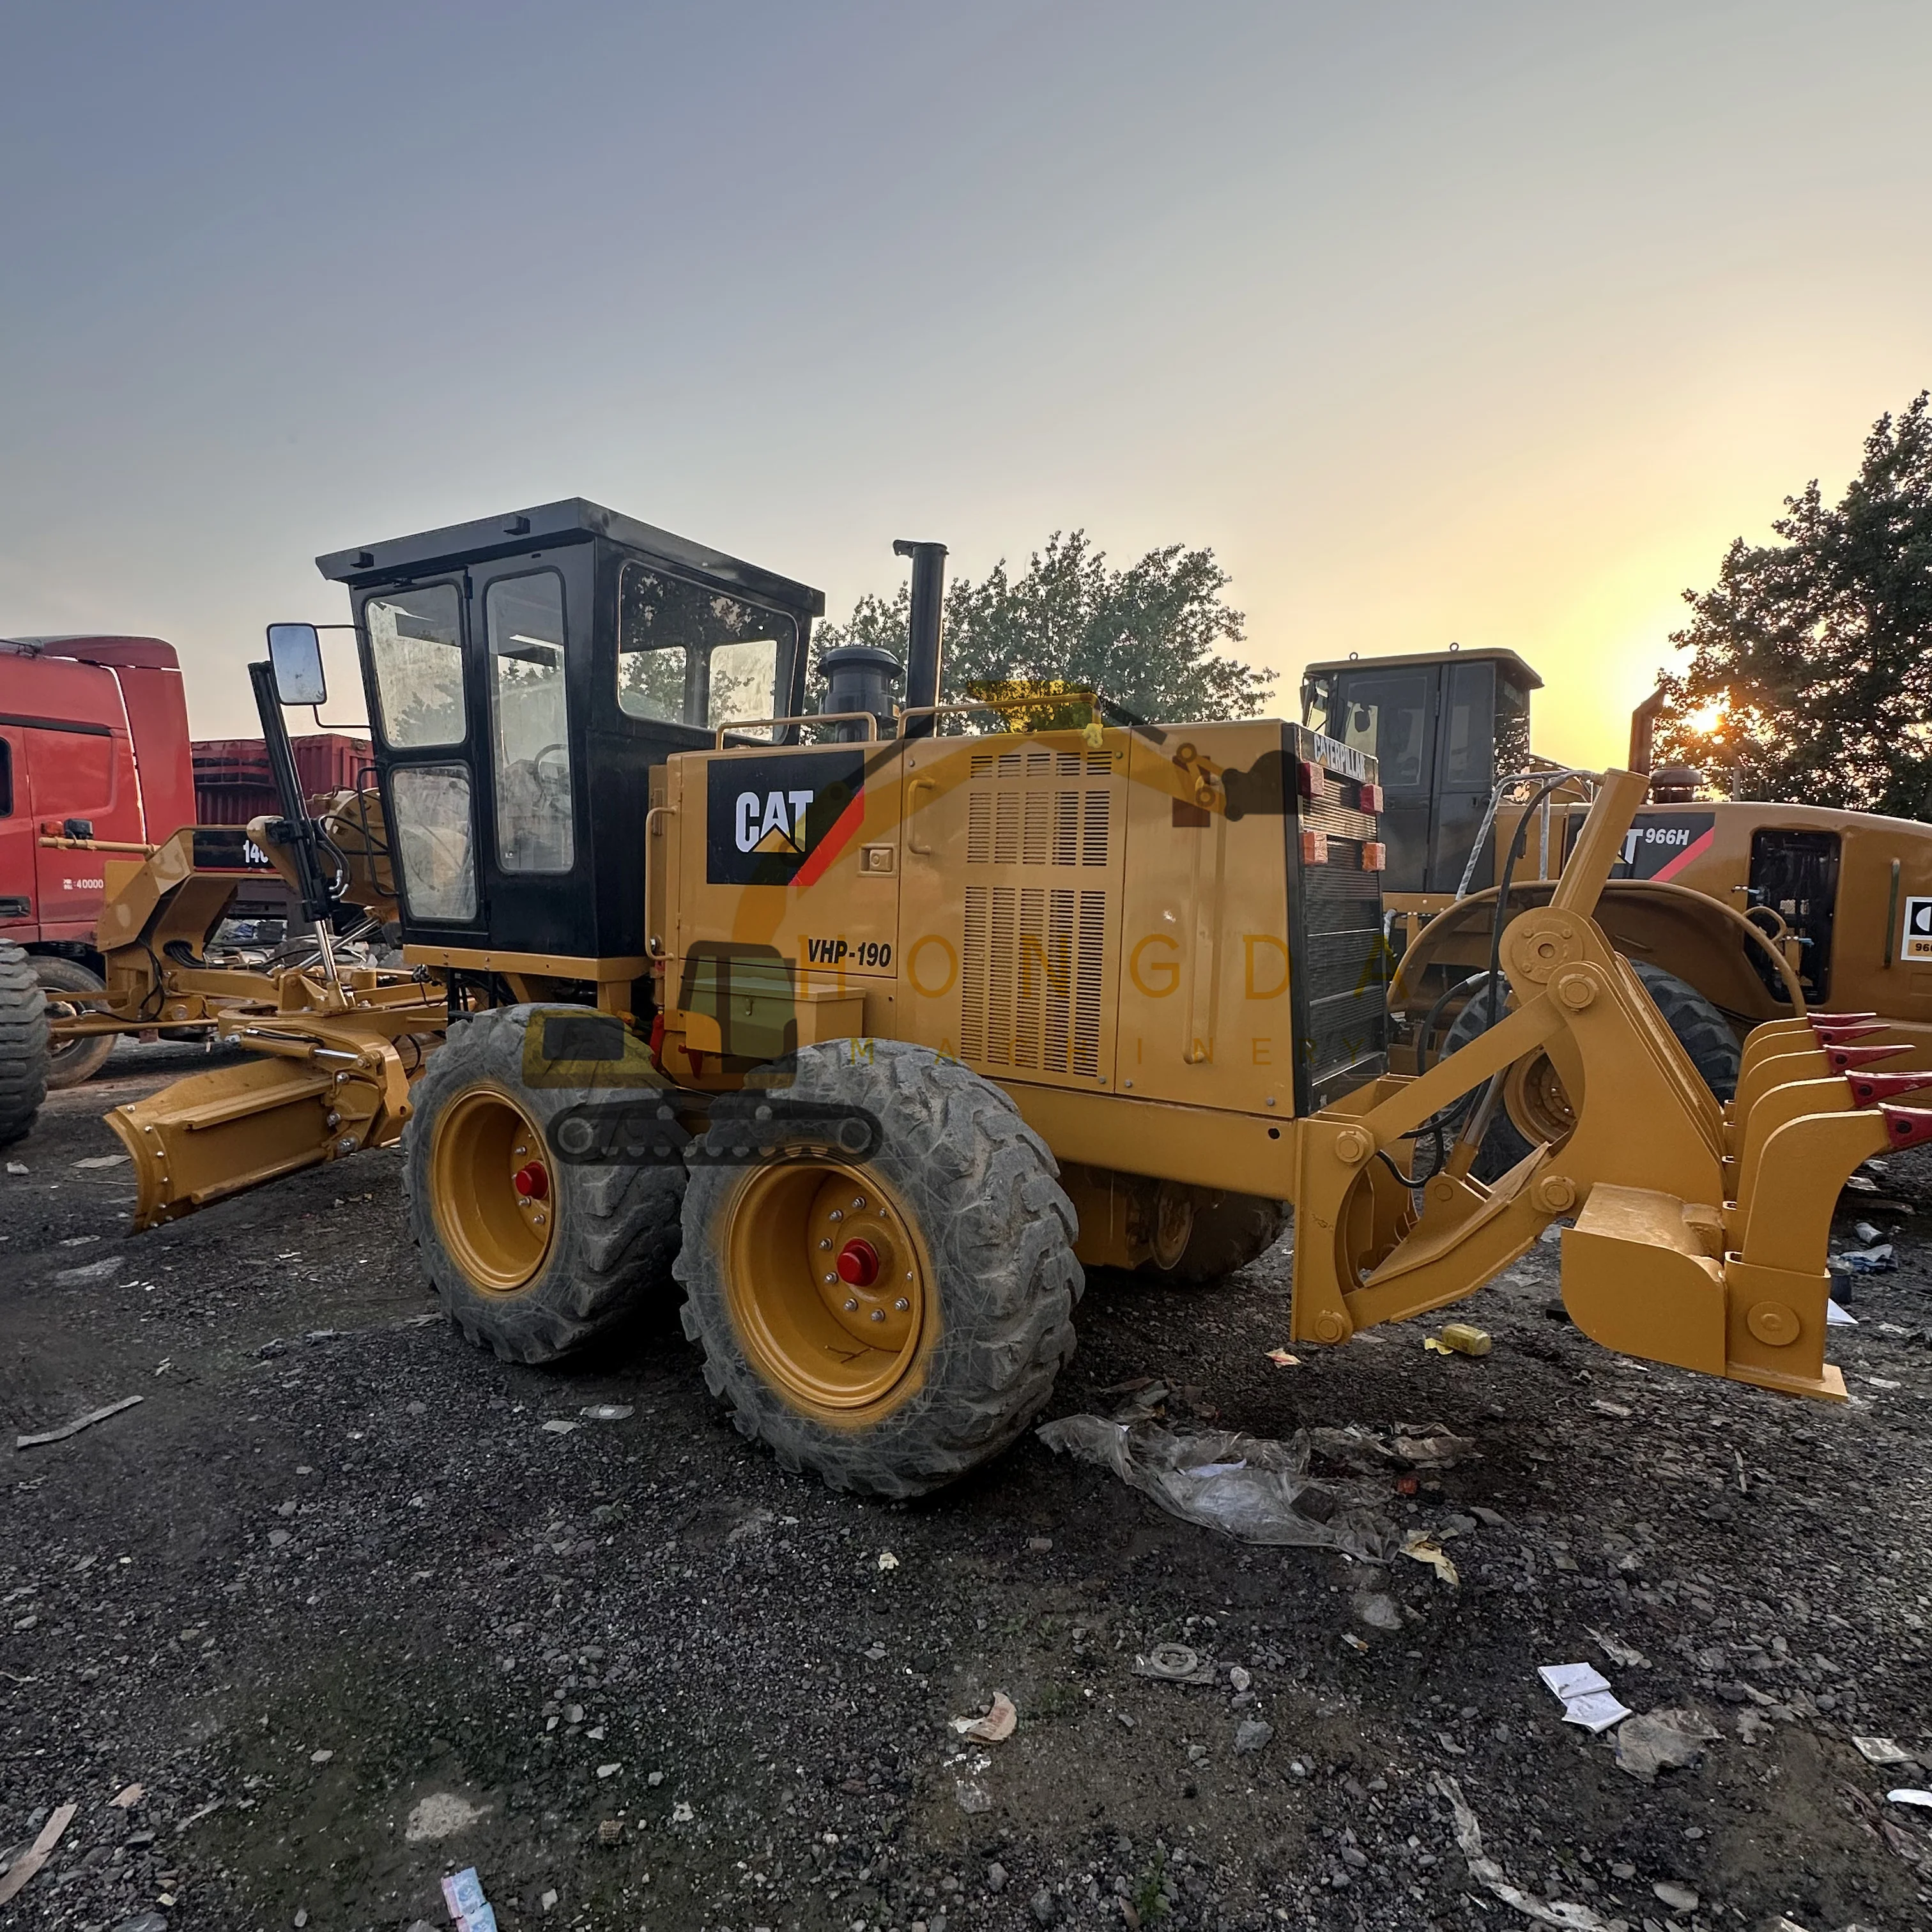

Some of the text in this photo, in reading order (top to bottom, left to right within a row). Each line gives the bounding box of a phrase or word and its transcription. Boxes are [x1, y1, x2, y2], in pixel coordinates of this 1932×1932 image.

[1314, 733, 1366, 781] CATERPILLAR
[735, 790, 813, 852] CAT
[1645, 828, 1689, 845] 966H
[808, 939, 891, 967] VHP-190
